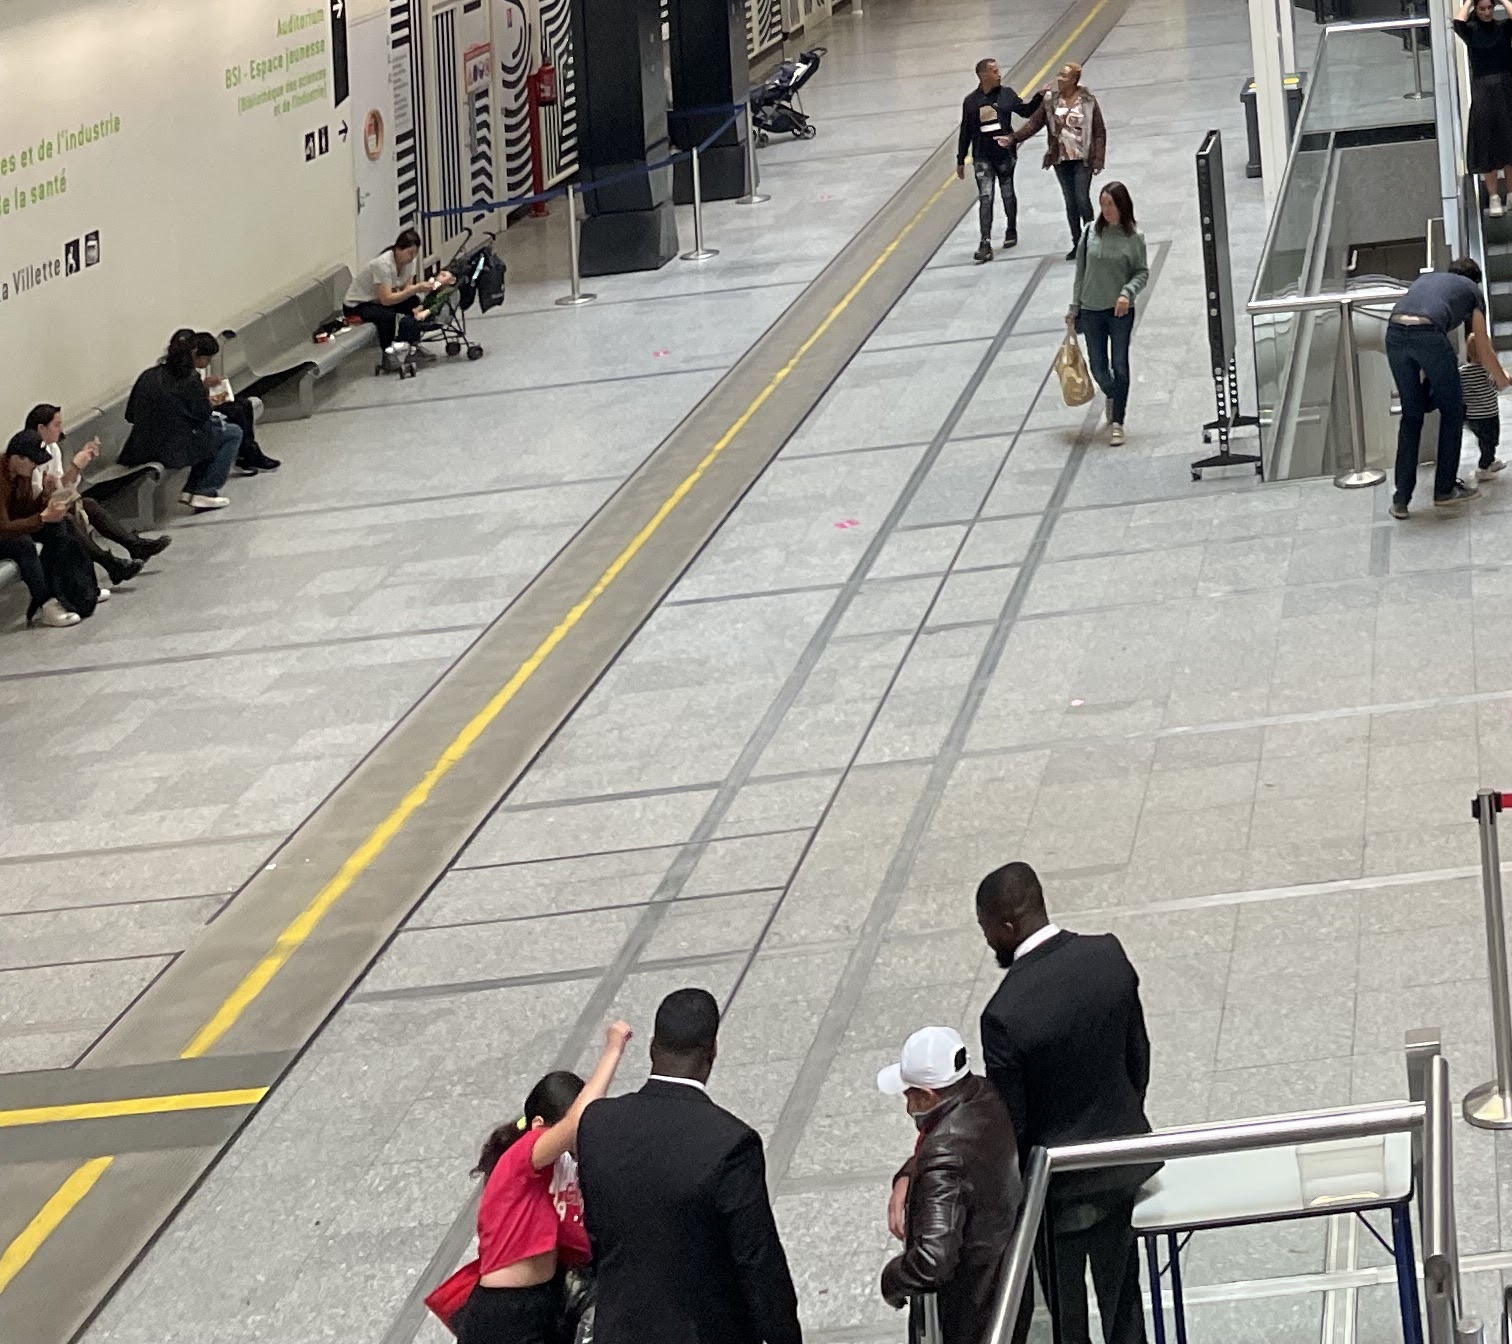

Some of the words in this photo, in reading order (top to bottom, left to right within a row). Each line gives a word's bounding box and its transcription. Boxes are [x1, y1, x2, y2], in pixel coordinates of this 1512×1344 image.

[276, 8, 325, 37] Auditorium
[225, 66, 241, 89] BSI
[250, 55, 283, 81] Espace
[285, 39, 326, 72] jeunesse
[20, 146, 34, 169] et
[37, 137, 53, 162] de
[57, 113, 121, 155] l'industrie
[14, 187, 27, 210] la
[30, 167, 67, 205] santé
[12, 258, 61, 296] Villette
